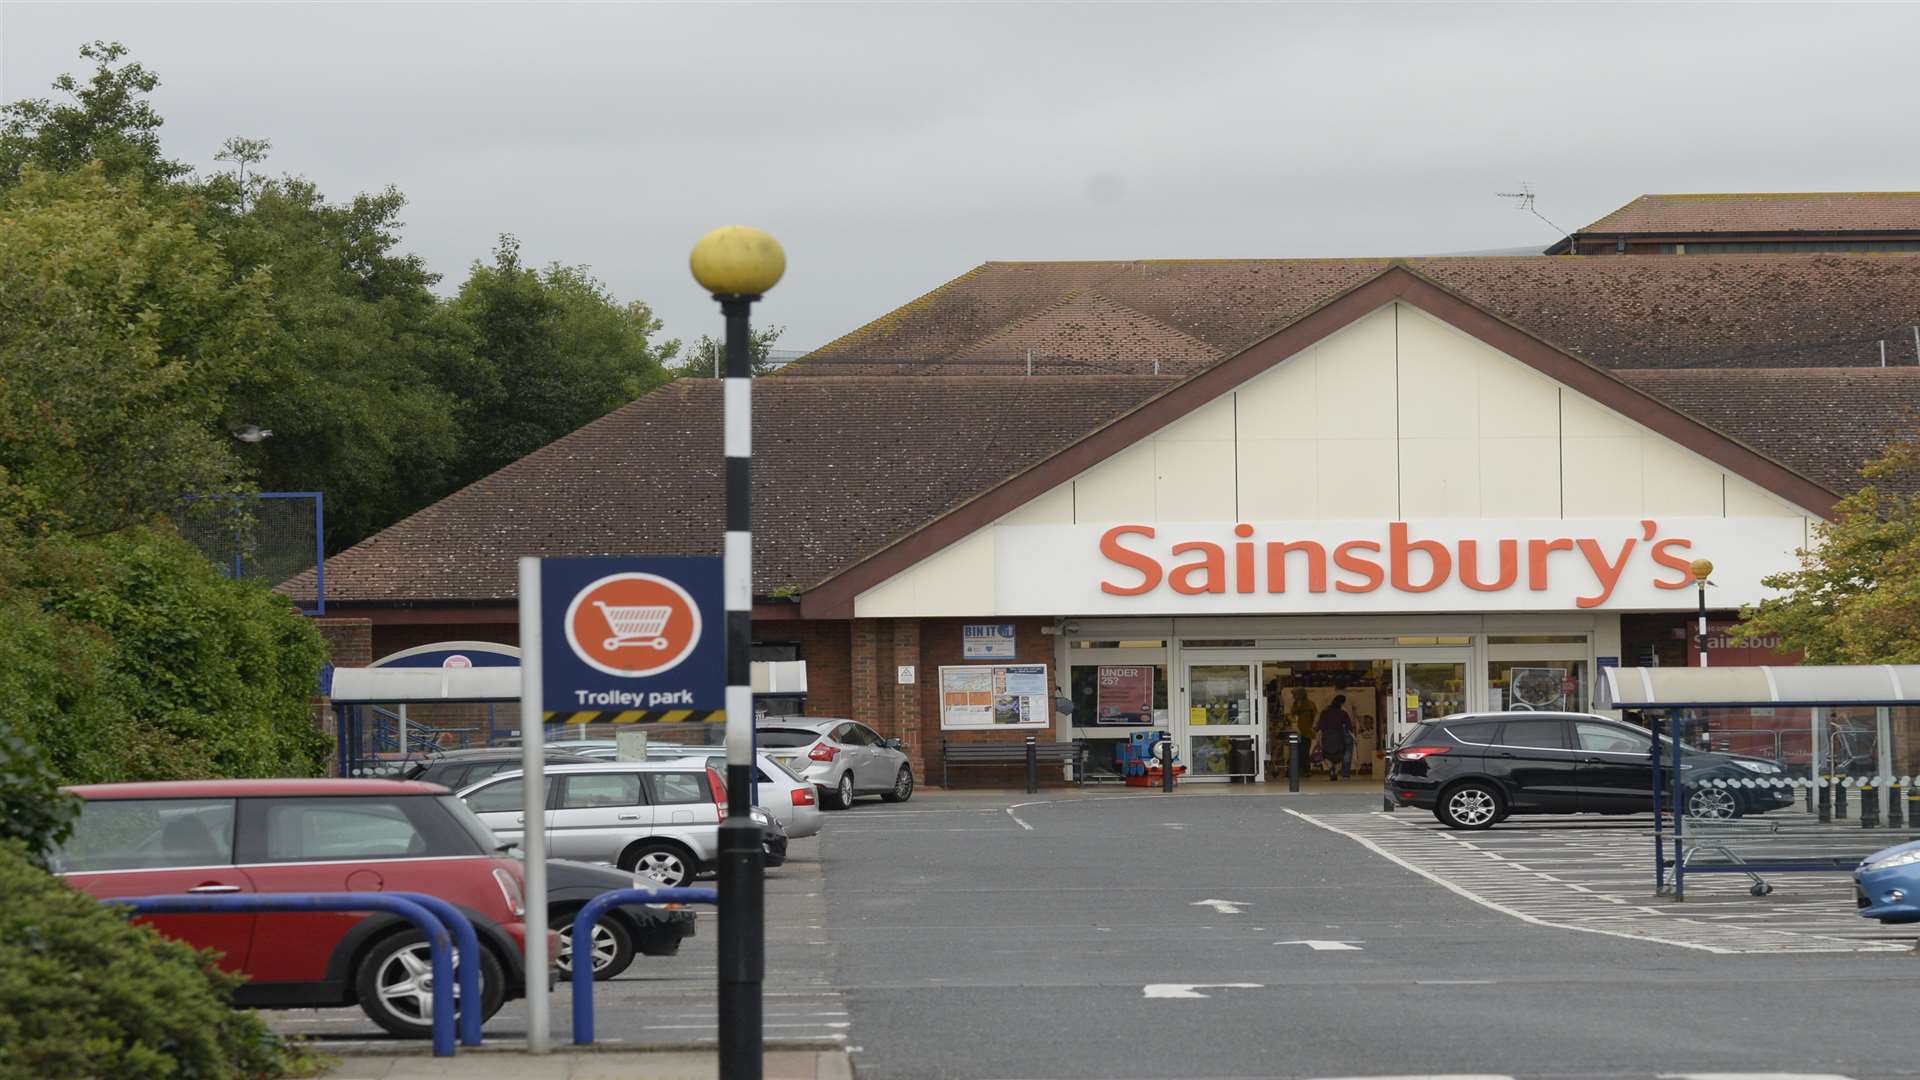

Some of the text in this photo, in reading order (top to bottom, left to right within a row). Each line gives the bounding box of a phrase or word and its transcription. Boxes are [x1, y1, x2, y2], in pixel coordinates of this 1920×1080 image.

[1099, 518, 1697, 609] Sainsbury's
[965, 626, 996, 637] BIN IT
[1101, 668, 1138, 677] UNDER
[575, 689, 694, 707] Trolley park
